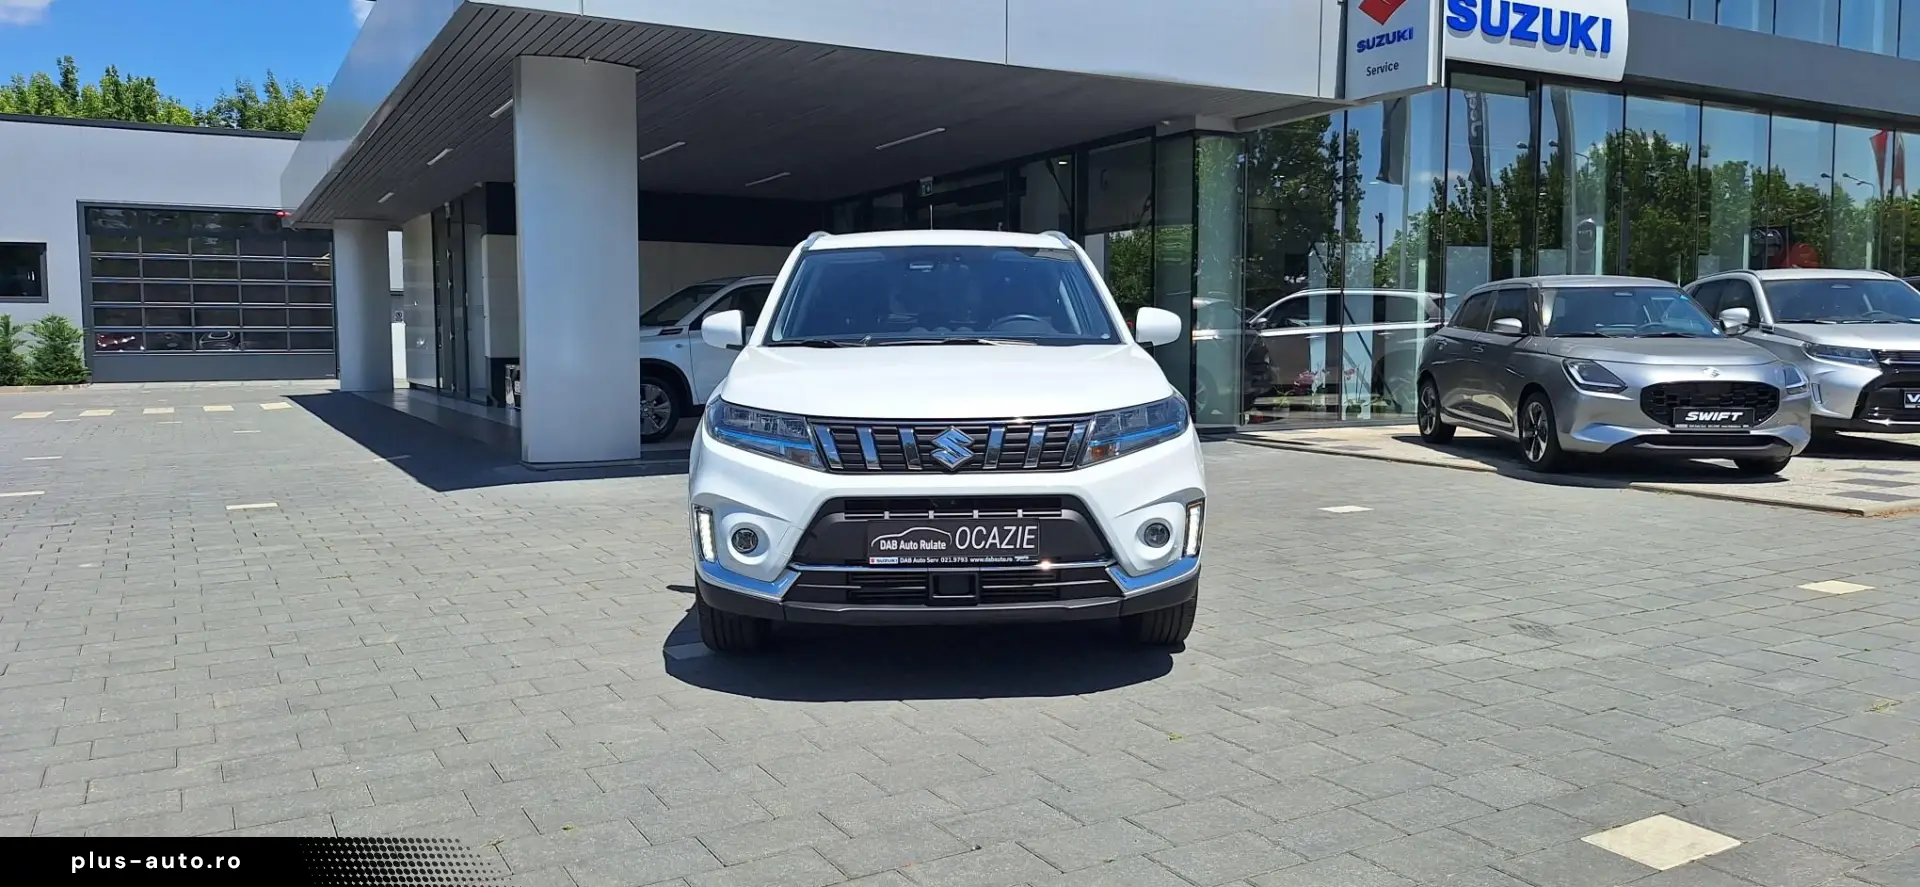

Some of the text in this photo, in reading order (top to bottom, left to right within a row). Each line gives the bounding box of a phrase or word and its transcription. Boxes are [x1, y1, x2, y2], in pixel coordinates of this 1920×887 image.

[1446, 0, 1612, 53] SUZUKI
[1356, 27, 1414, 53] SUZUKI
[1366, 60, 1400, 77] Service
[1685, 411, 1744, 421] SWIFT
[879, 539, 946, 550] DAB Auto Rulate
[955, 526, 1037, 549] OCAZIE
